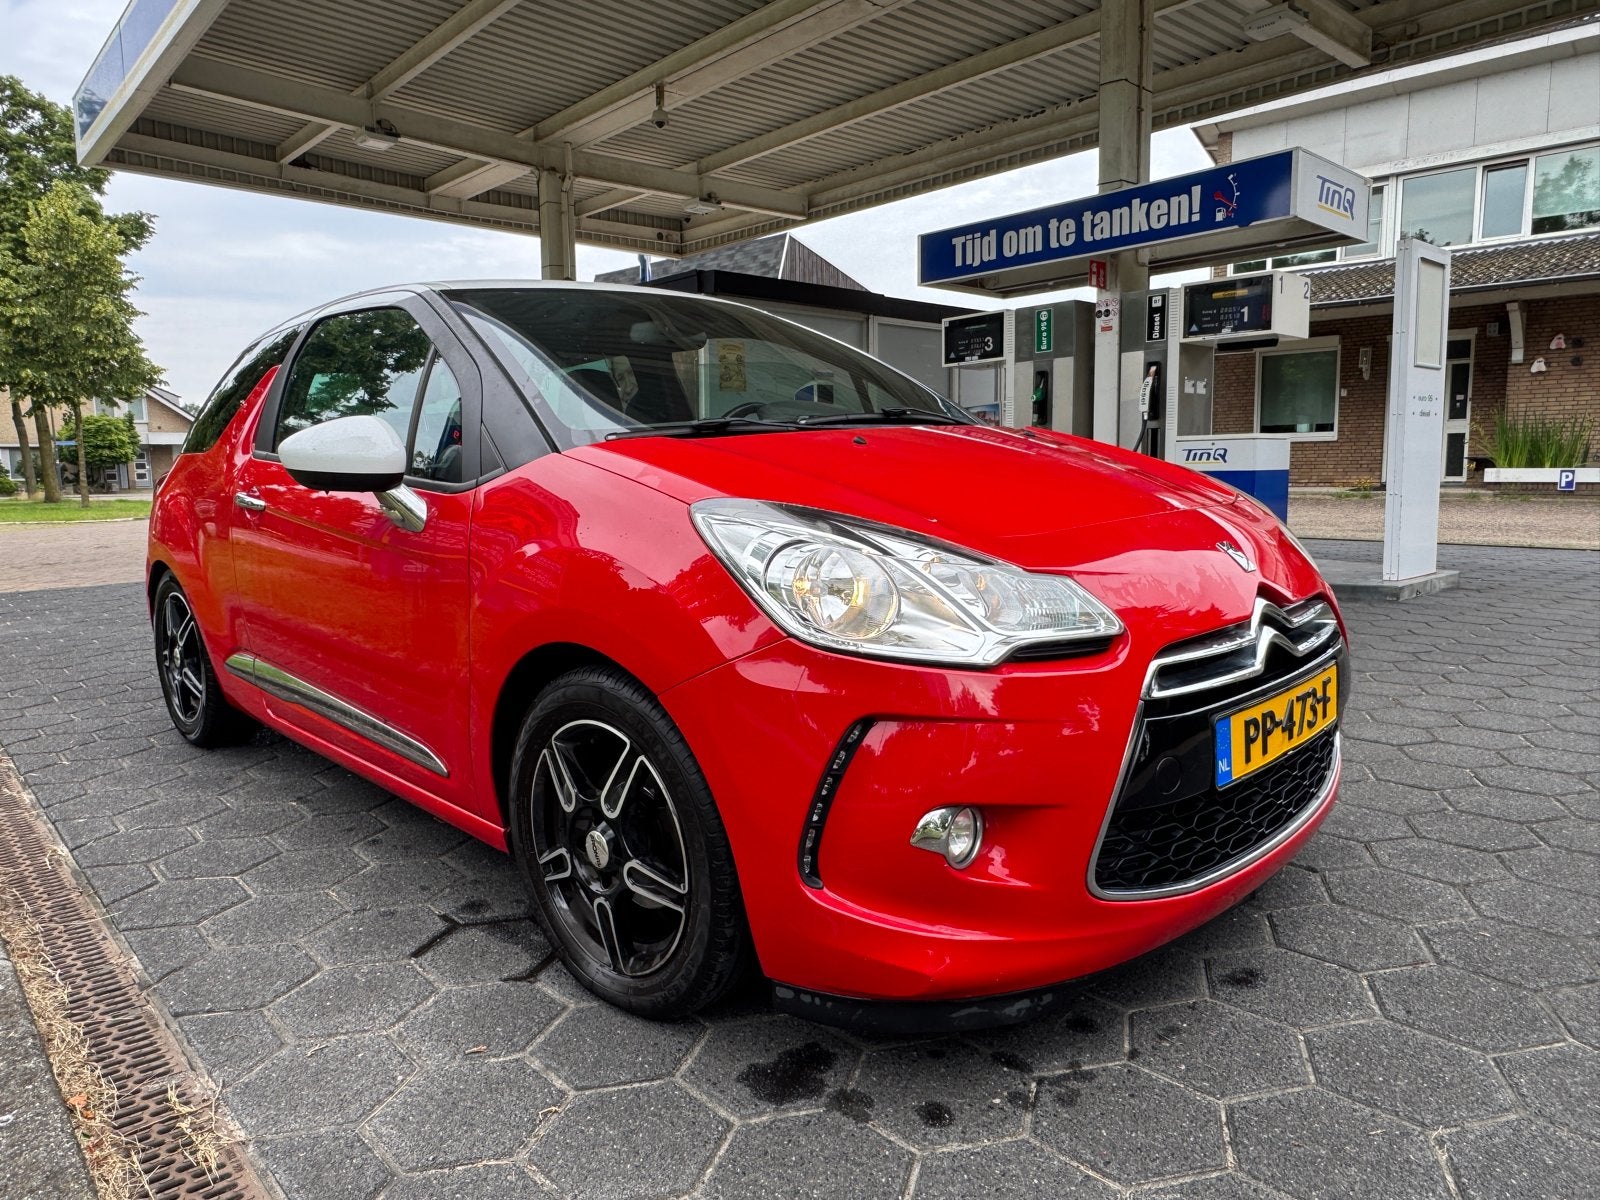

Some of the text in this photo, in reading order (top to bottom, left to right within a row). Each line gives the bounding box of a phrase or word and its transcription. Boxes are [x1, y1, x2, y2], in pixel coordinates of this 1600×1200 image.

[1316, 174, 1356, 221] TinQ
[952, 184, 1202, 267] Tijd om te tanken!
[1279, 275, 1284, 295] 1
[1303, 281, 1309, 300] 2
[1240, 305, 1249, 323] 1
[1040, 321, 1047, 331] 95
[1152, 313, 1161, 339] Diesel
[984, 336, 994, 351] 3
[1182, 447, 1228, 464] TinQ
[1560, 472, 1574, 487] P
[1218, 757, 1231, 775] NL
